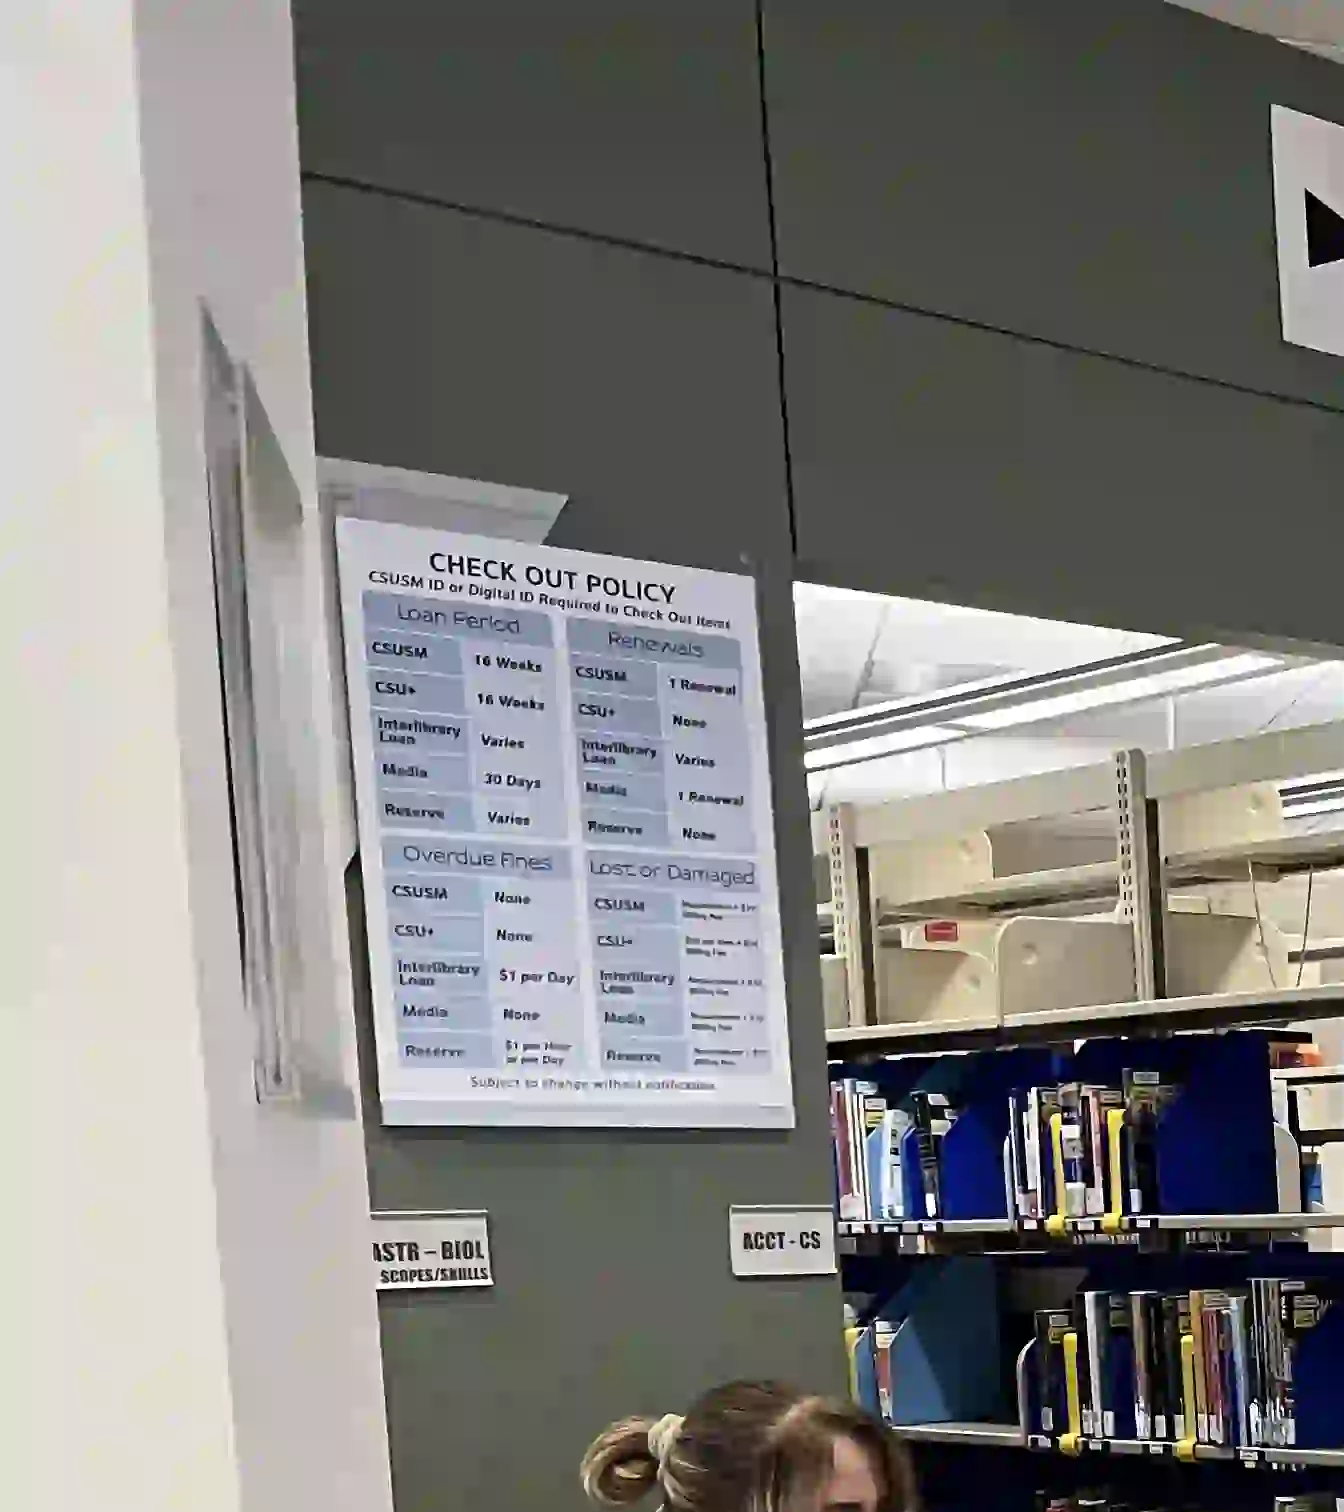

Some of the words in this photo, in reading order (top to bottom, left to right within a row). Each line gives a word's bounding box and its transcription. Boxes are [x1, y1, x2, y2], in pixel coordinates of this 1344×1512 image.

[429, 552, 517, 582] CHECK
[525, 566, 578, 592] OUT
[586, 574, 677, 605] POLICY
[368, 570, 425, 590] CSUSM
[428, 579, 445, 591] ID
[448, 583, 464, 594] or
[468, 583, 516, 603] Digital
[519, 590, 534, 602] ID
[538, 592, 601, 614] Required
[605, 602, 619, 615] to
[623, 605, 664, 621] Check
[667, 610, 692, 625] Out
[397, 603, 447, 626] Loan
[452, 610, 521, 635] Period
[372, 641, 429, 659] CSUSM
[607, 630, 705, 658] Renewals
[475, 654, 491, 667] 16
[496, 656, 542, 673] Weeks
[575, 666, 628, 682] CSUSM
[680, 678, 736, 696] Renewal
[477, 693, 494, 706] 16
[498, 695, 545, 711] Weeks
[378, 716, 461, 740] Interlibrary
[672, 714, 708, 729] None
[379, 731, 416, 745] Loan
[480, 733, 525, 749] Varies
[581, 739, 657, 759] Interlibrary
[675, 753, 716, 768] Varies
[382, 763, 428, 778] Media
[506, 774, 542, 792] Days
[488, 811, 530, 826] Varies
[402, 845, 497, 867] Overdue
[500, 851, 553, 871] Fines
[590, 859, 637, 878] Lost
[639, 865, 661, 879] or
[667, 862, 755, 888] Damaged
[391, 884, 448, 901] CSUSM
[494, 891, 532, 905] None
[594, 897, 646, 913] CSUSM
[496, 928, 533, 943] None
[398, 959, 481, 977] Interlibrary
[499, 967, 516, 982] $1
[520, 971, 543, 985] per
[547, 971, 576, 986] Day
[400, 972, 435, 987] Loan
[403, 1004, 448, 1018] Media
[503, 1008, 541, 1021] None
[470, 1075, 520, 1090] Subject
[441, 1240, 485, 1260] BIOL
[742, 1231, 787, 1252] ACCT
[799, 1231, 822, 1250] CS
